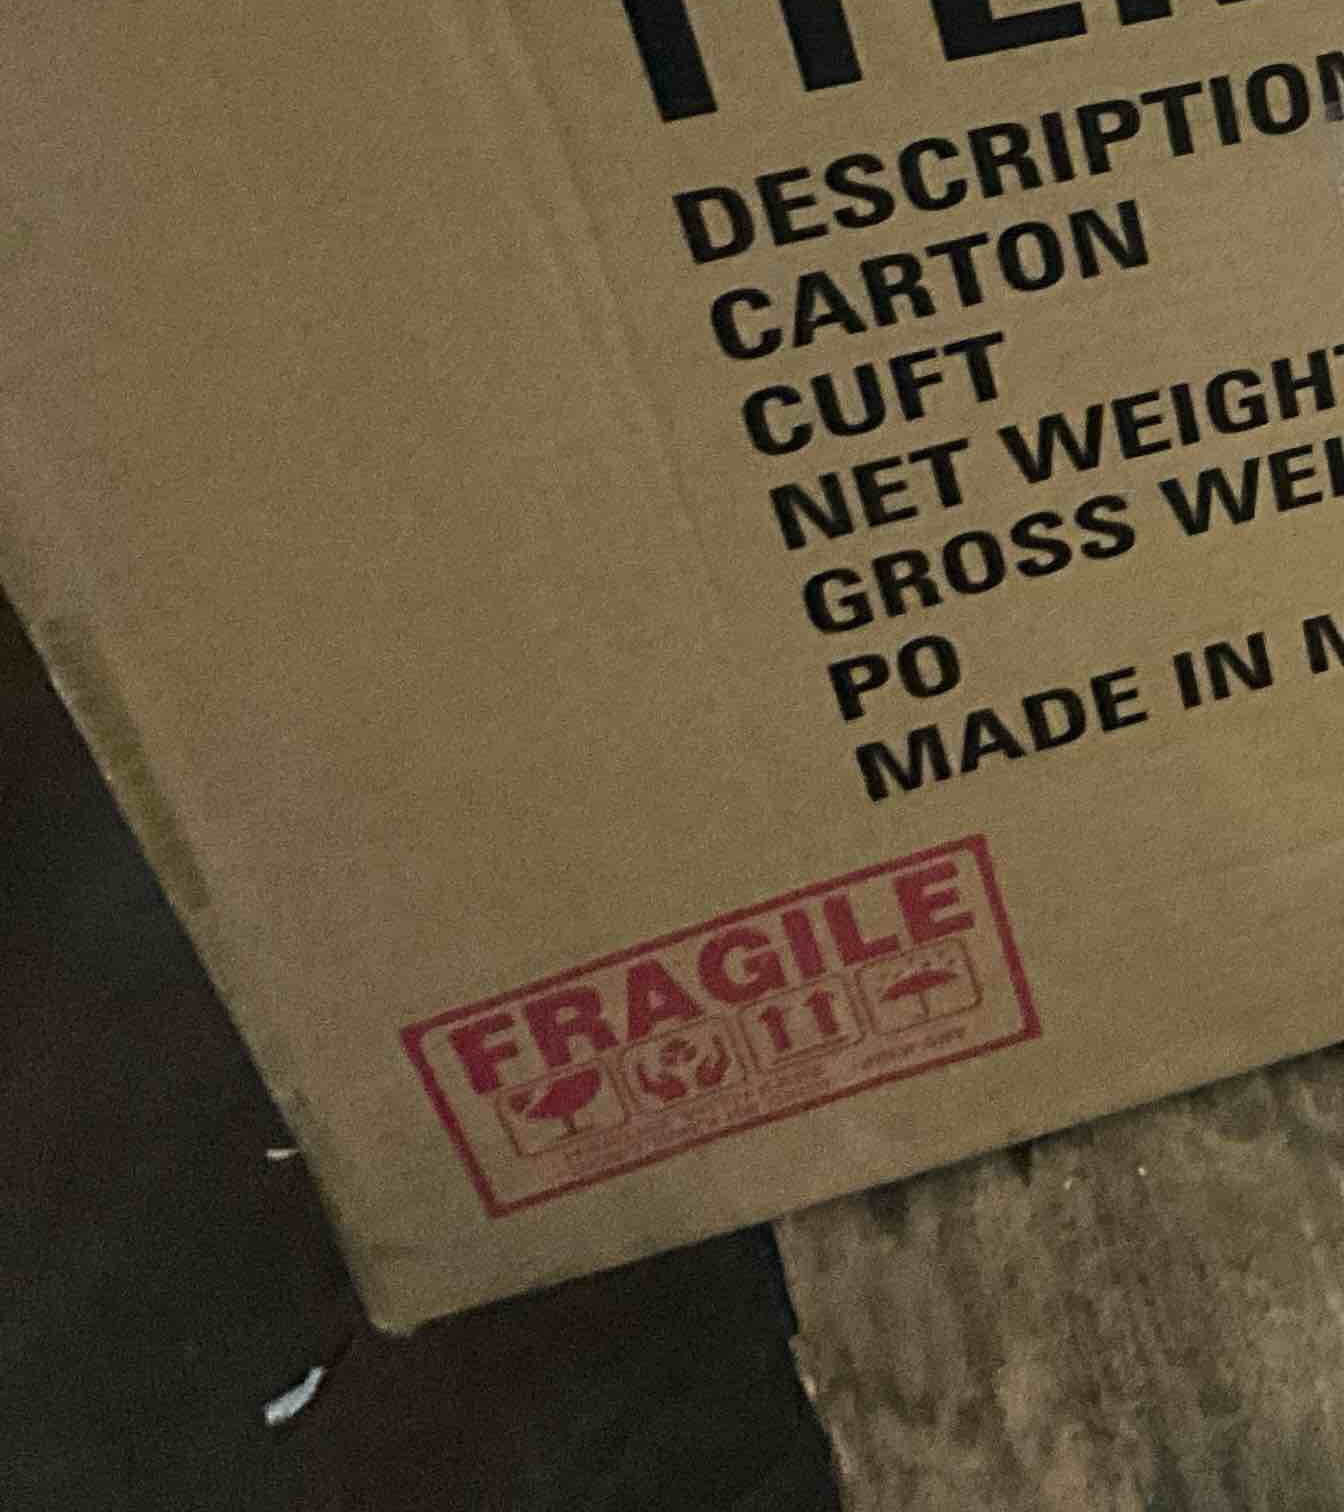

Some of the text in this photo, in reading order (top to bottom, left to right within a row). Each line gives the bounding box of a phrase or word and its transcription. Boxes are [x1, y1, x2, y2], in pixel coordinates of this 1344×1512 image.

[710, 198, 1150, 362] CARTON
[741, 330, 1006, 458] CUFT
[768, 437, 970, 551] NET
[802, 492, 1138, 635] GROSS
[827, 632, 963, 724] PO
[855, 664, 1149, 804] MADE
[1172, 630, 1275, 711] IN
[447, 859, 976, 1096] FRAGILE
